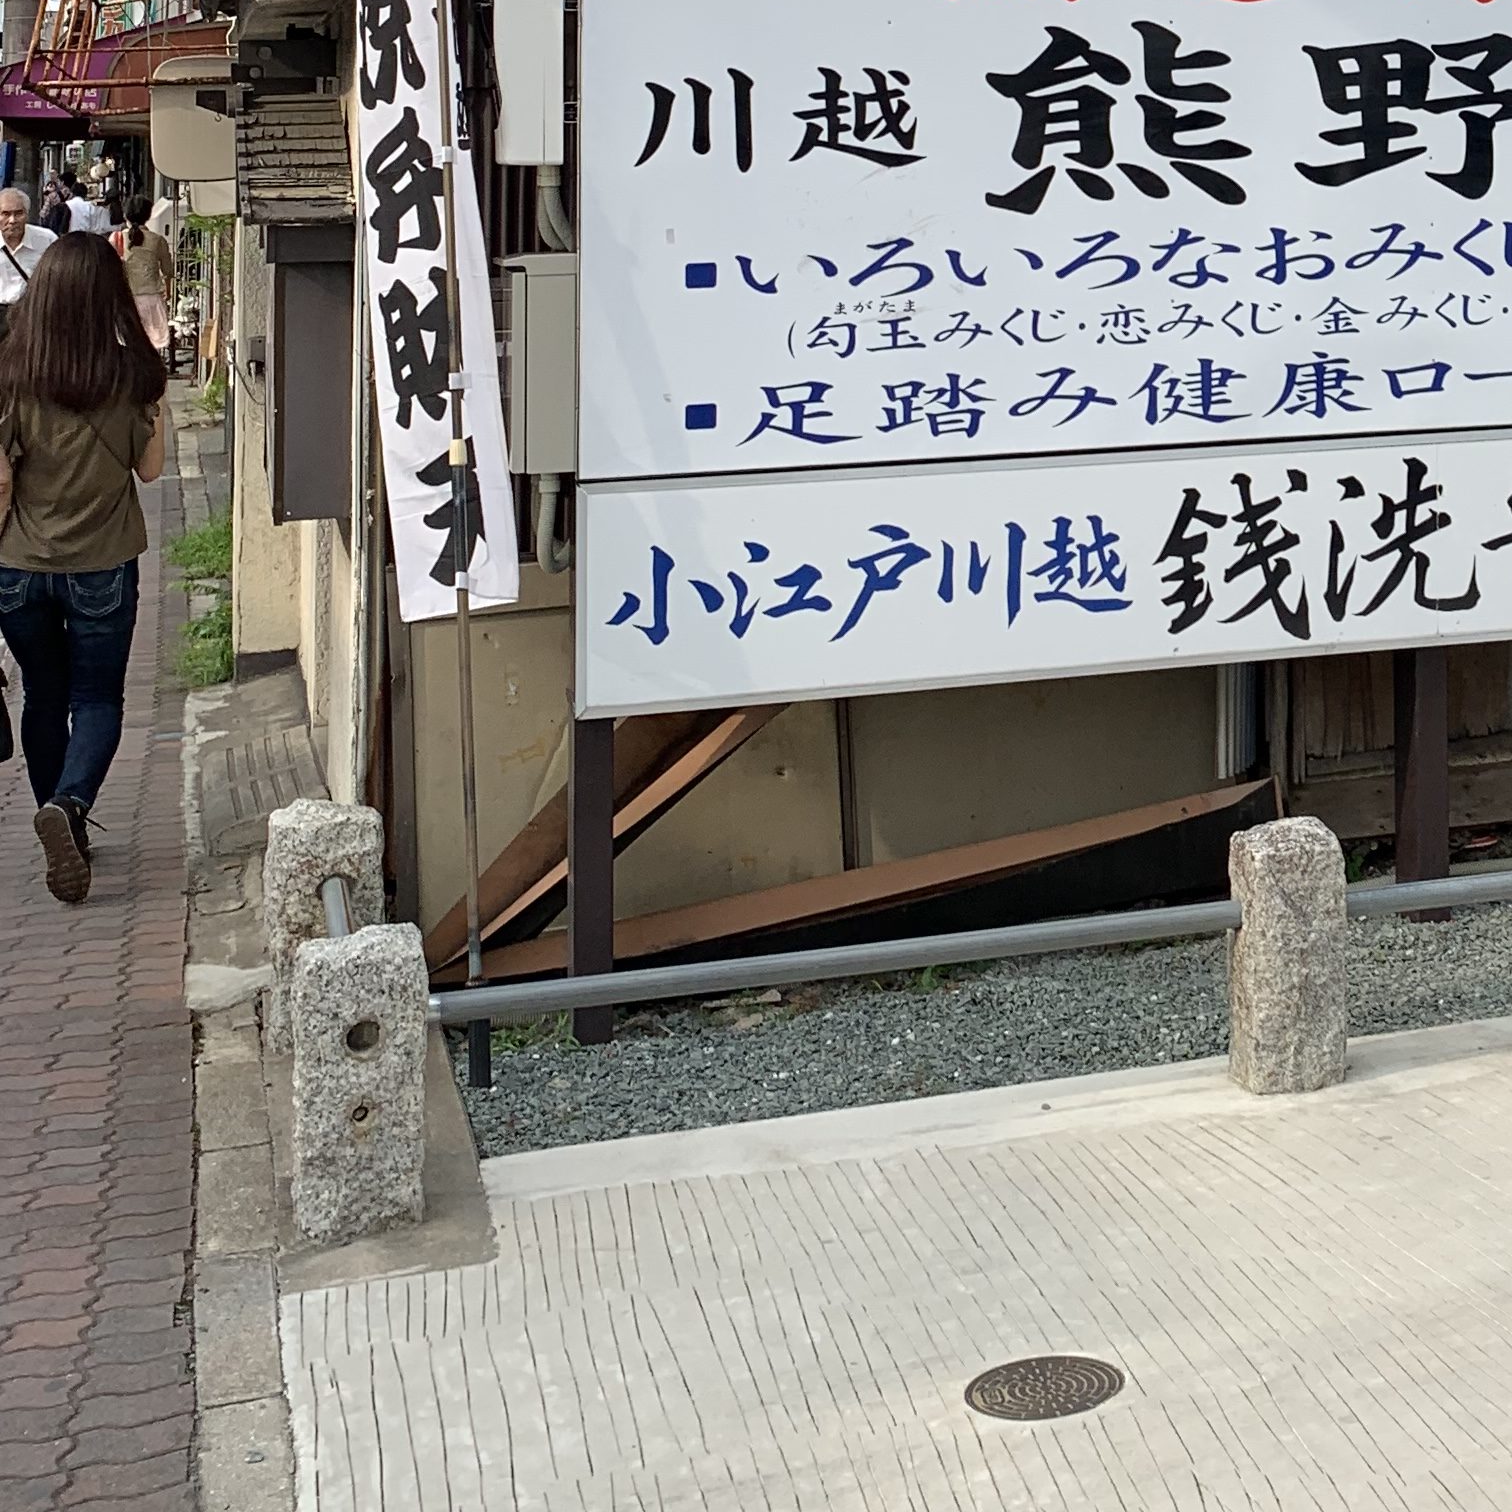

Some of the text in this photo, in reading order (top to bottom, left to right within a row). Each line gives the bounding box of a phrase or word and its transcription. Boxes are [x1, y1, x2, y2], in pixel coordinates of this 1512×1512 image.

[635, 67, 927, 173] 川越
[834, 299, 918, 313] まがたま
[605, 514, 1134, 645] 小江戸川越
